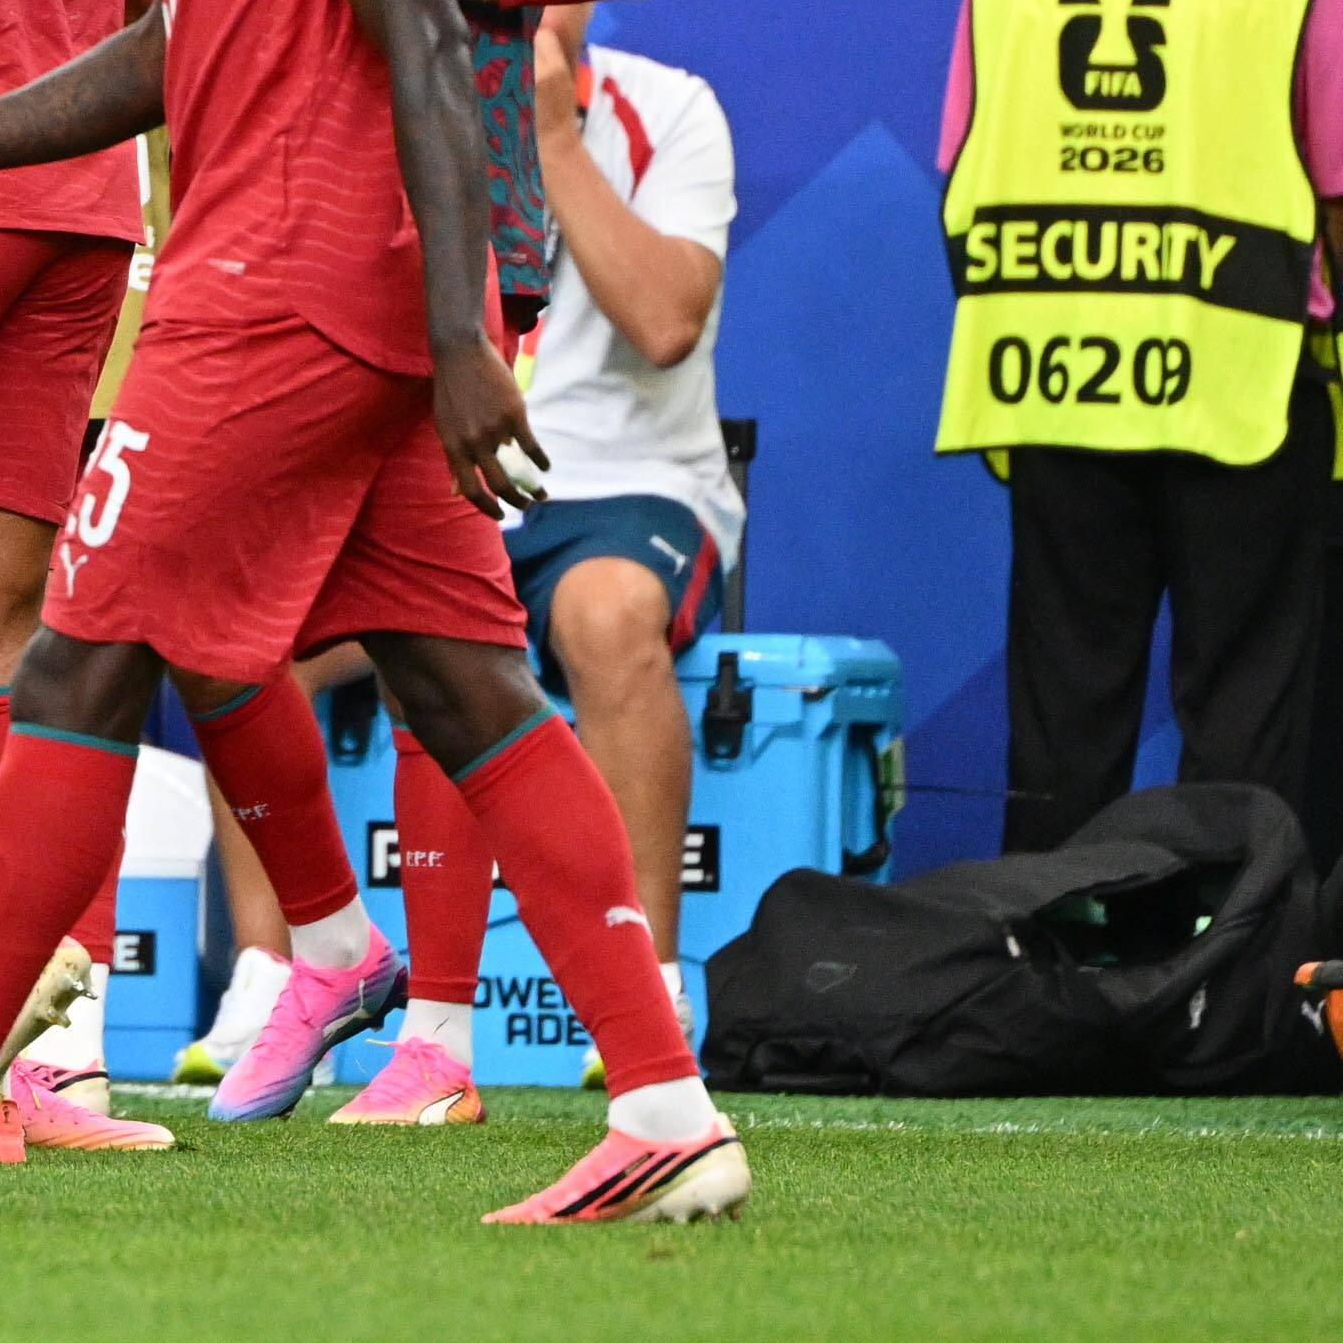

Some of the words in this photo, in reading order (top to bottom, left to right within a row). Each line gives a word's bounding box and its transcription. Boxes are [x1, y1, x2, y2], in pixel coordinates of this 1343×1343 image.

[1084, 70, 1142, 98] FIFA
[1060, 123, 1127, 140] WORLD
[1131, 123, 1165, 141] CUP
[1060, 146, 1165, 174] 2026
[965, 219, 1237, 291] SECURITY
